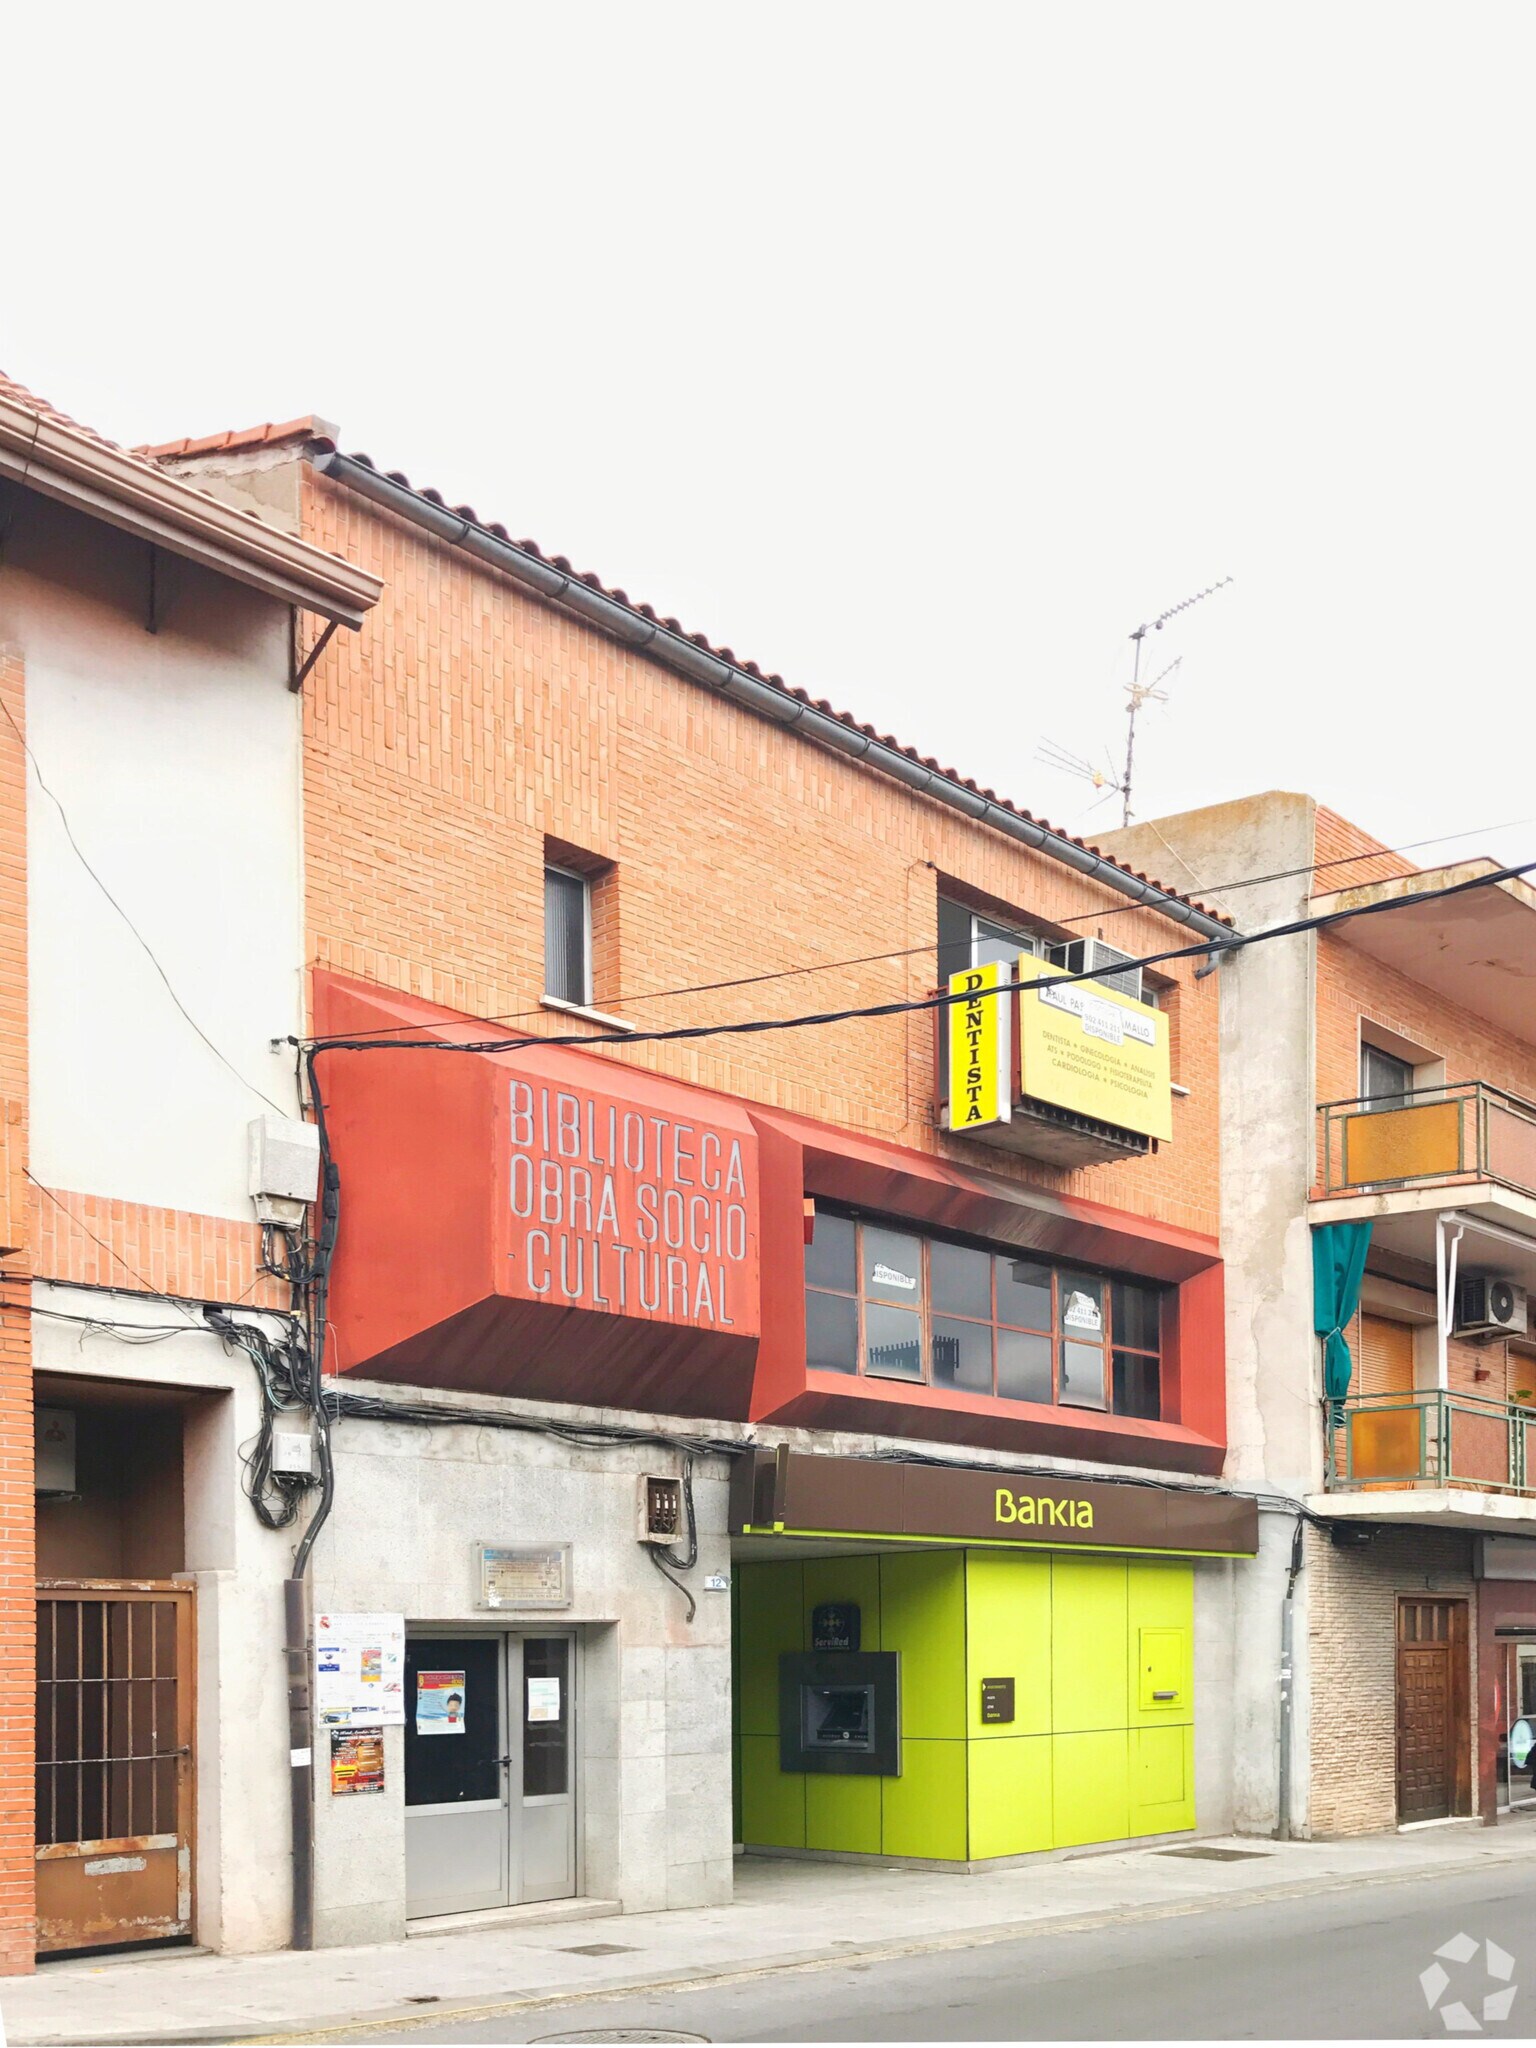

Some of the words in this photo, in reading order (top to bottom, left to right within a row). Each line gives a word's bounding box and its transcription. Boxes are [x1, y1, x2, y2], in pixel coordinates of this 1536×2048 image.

[965, 973, 984, 1122] DENTISTA
[1042, 1030, 1071, 1047] DENTISTA
[1080, 1045, 1121, 1066] GINECOLOGIA
[1130, 1064, 1156, 1079] ANALISIS
[1047, 1044, 1058, 1054] ATS
[1066, 1051, 1101, 1070] PODOLOGO
[1109, 1067, 1153, 1088] FISIOTERAPEUTA
[1051, 1058, 1100, 1081] CARDIOLOGIA
[1110, 1079, 1148, 1099] PSICOLOGIA
[509, 1079, 746, 1199] BIBLIOTECA
[509, 1153, 620, 1237] OBRA
[636, 1183, 747, 1260] SOCIO
[526, 1229, 735, 1325] CULTURAL
[876, 1270, 913, 1285] ISPONIBLE
[995, 1488, 1094, 1529] Bankia
[711, 1578, 722, 1587] 12
